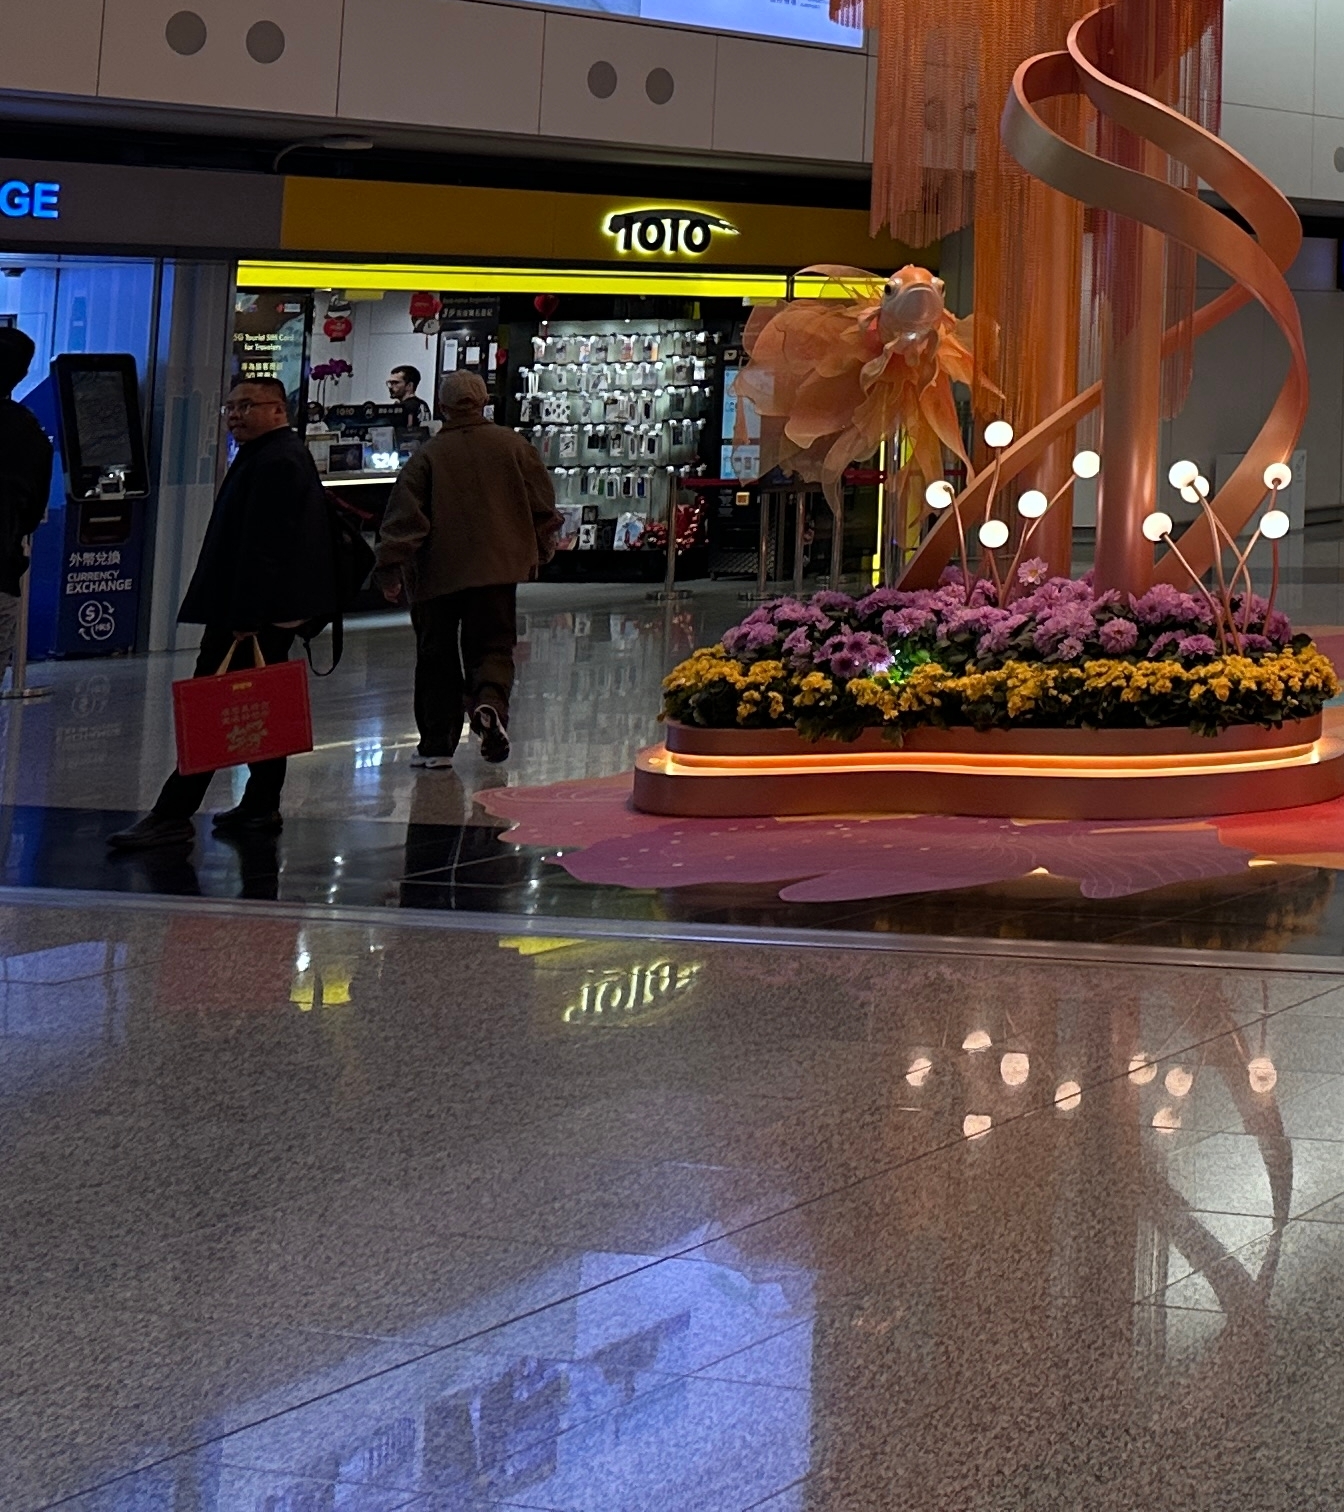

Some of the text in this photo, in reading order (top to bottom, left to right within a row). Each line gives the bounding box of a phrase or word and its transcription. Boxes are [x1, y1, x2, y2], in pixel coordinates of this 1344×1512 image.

[0, 180, 60, 218] GE
[67, 569, 120, 582] CURRENCY
[66, 578, 133, 595] EXCHANGE
